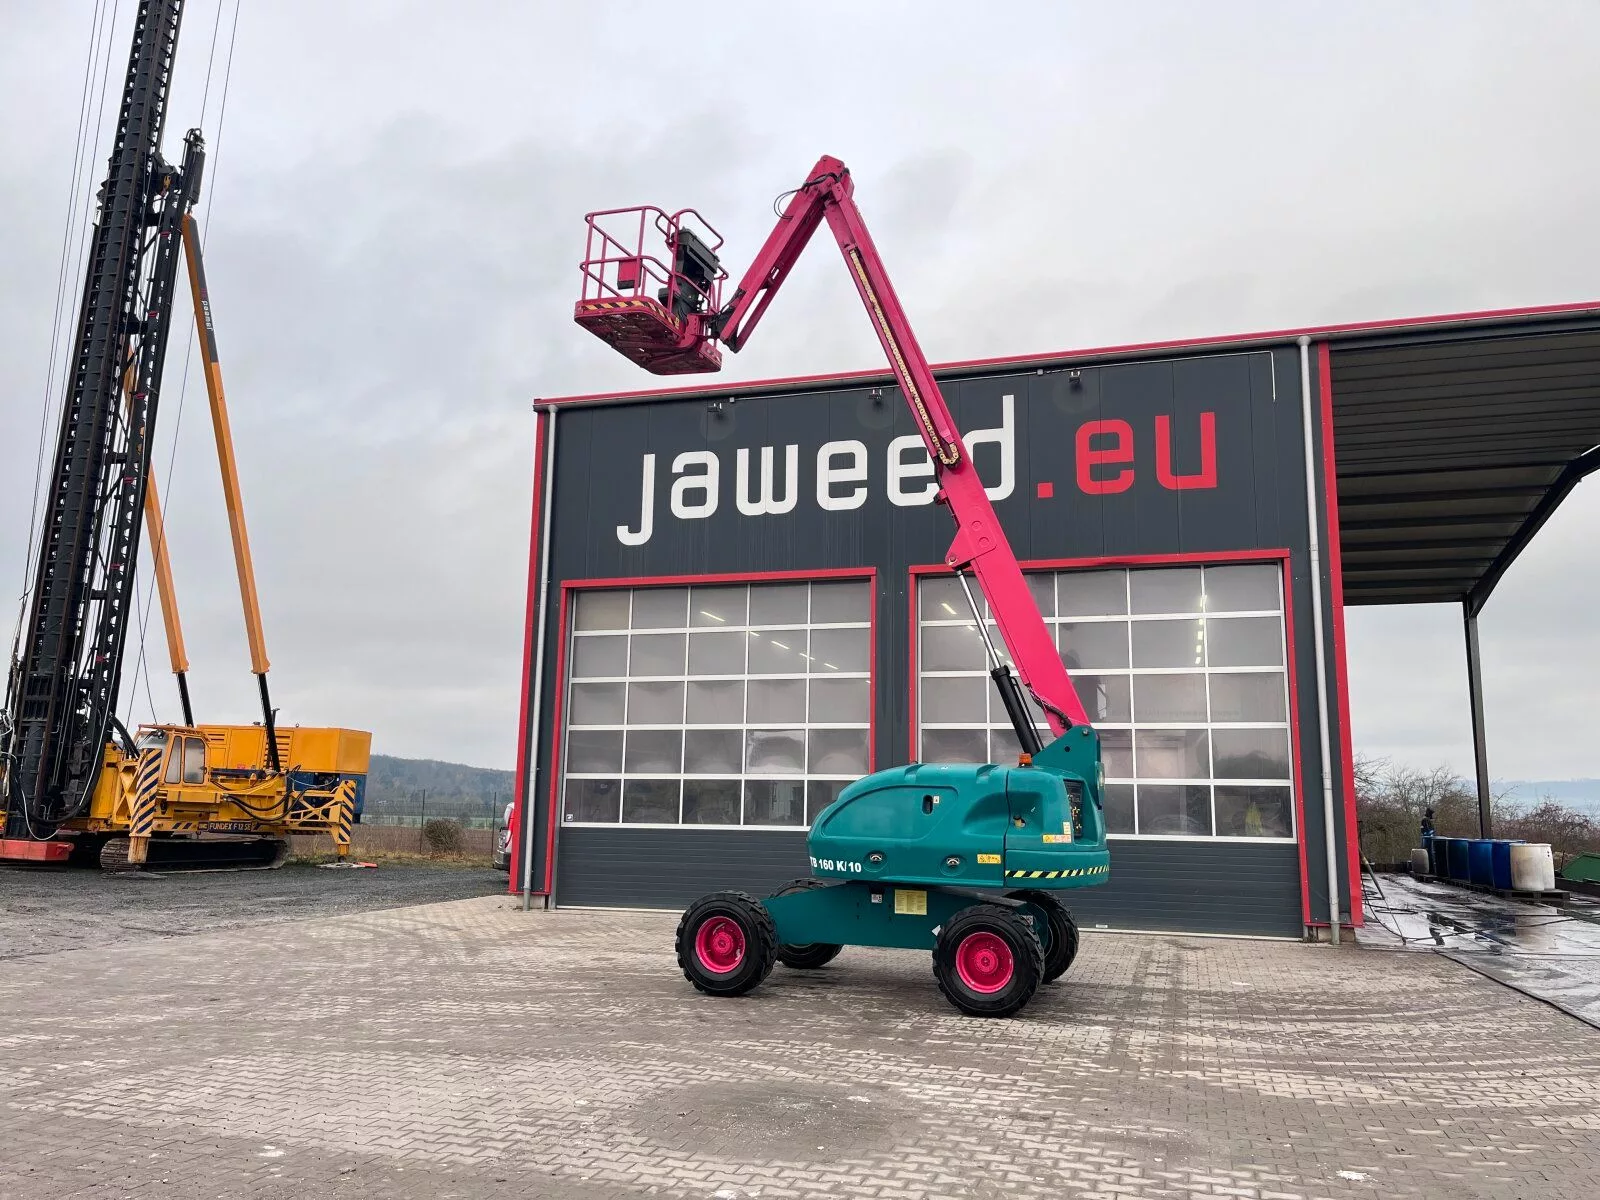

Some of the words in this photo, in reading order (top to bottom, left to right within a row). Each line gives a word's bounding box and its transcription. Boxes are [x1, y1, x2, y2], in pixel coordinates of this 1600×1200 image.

[616, 395, 1217, 546] jaweed.eu
[209, 822, 232, 830] FUNDEX
[819, 858, 834, 871] 160
